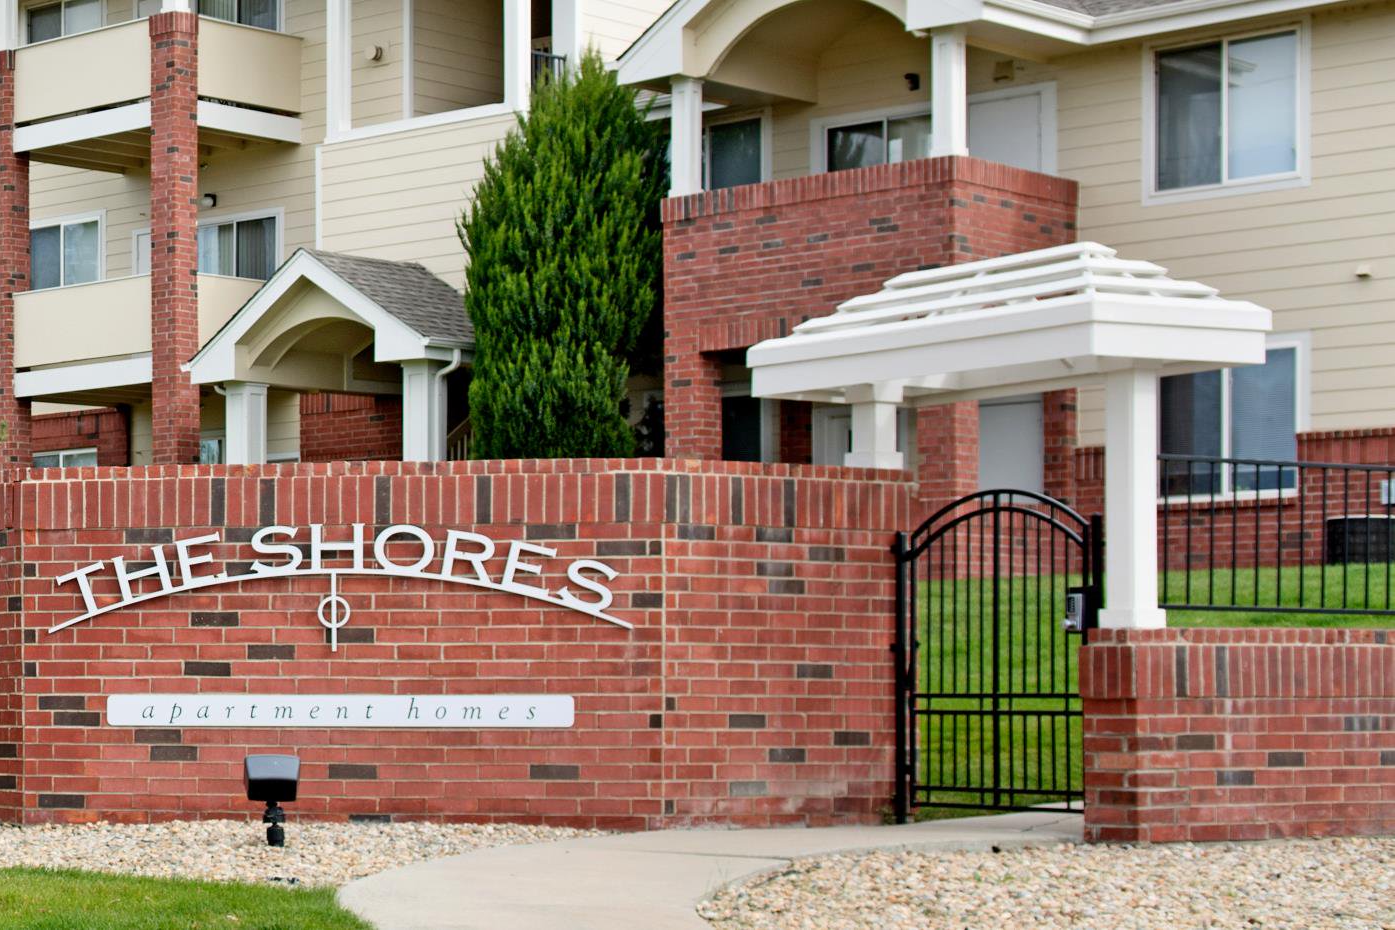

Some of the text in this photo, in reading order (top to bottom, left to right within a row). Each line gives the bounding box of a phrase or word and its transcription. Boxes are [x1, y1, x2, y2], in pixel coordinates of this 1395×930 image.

[56, 523, 619, 615] THE SHORES
[141, 697, 538, 723] apartment homes
